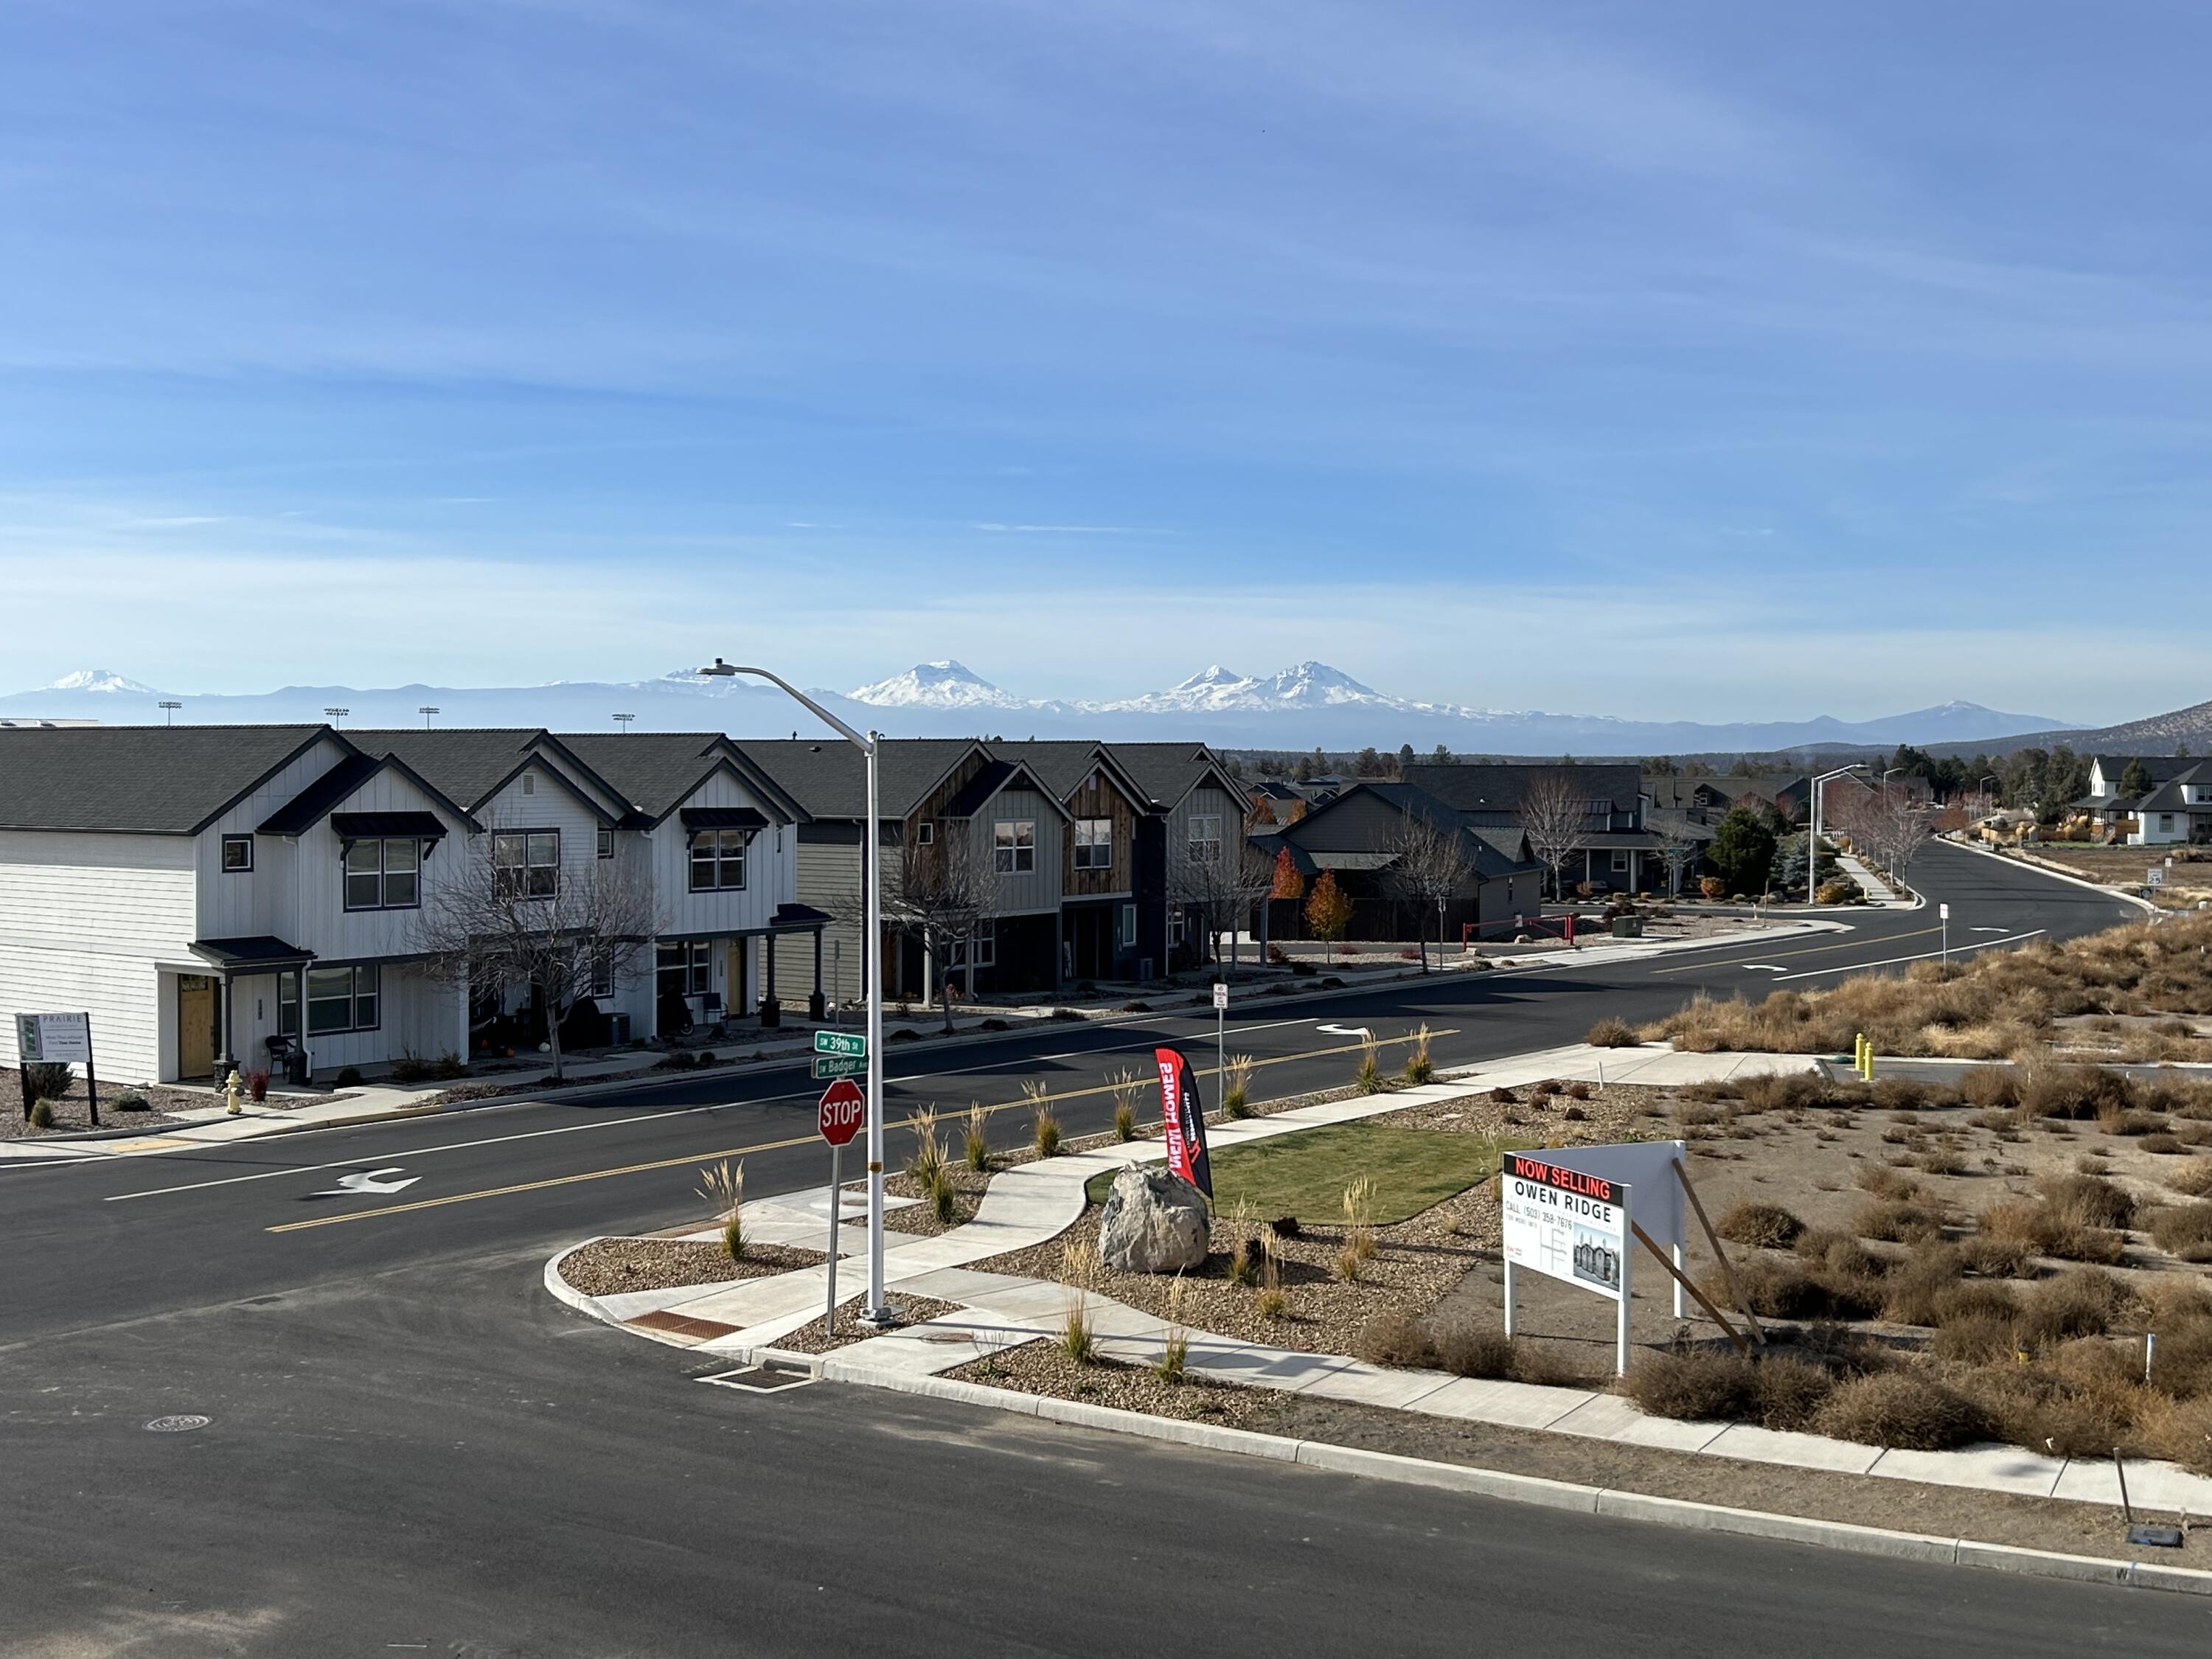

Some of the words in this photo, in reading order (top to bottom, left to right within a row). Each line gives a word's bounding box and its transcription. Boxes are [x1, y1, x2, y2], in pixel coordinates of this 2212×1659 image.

[43, 1015, 82, 1023] PRAIRIE
[830, 1037, 850, 1051] 39th
[852, 1041, 858, 1051] St
[829, 1060, 856, 1074] Badger
[822, 1099, 860, 1127] STOP
[1515, 1158, 1547, 1180] NOW
[1551, 1167, 1610, 1200] SELLING
[1506, 1200, 1521, 1214] CALL
[1523, 1206, 1540, 1220] (503)
[1515, 1181, 1557, 1206] OWEN
[1565, 1194, 1611, 1222] RIDGE
